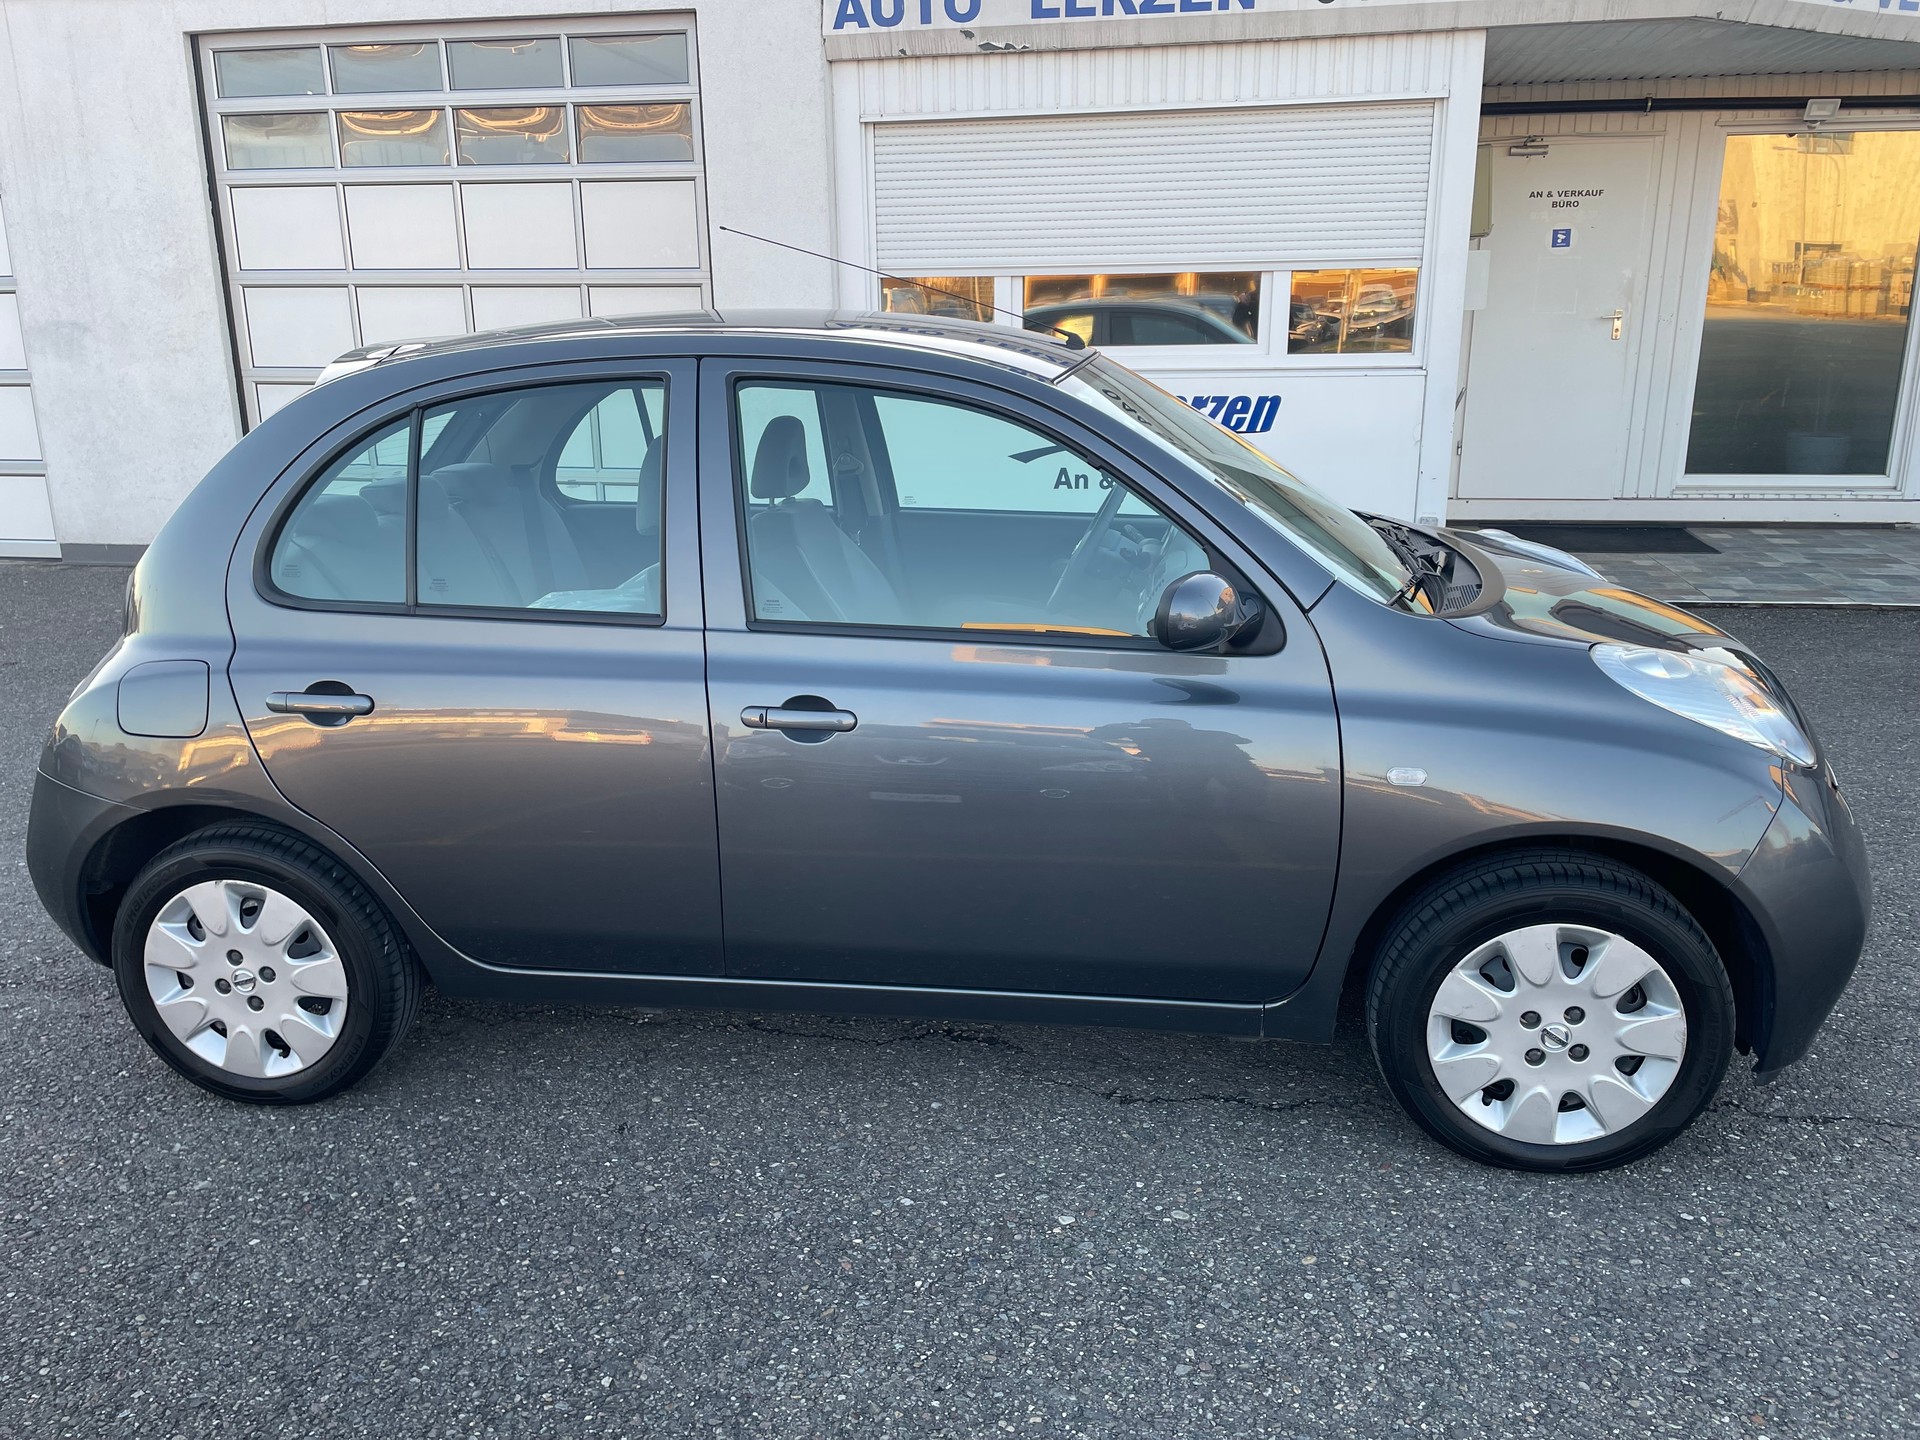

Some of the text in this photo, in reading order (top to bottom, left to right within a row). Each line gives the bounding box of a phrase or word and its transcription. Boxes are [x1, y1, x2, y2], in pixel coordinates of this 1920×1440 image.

[833, 0, 981, 29] AUTO
[1529, 189, 1605, 199] AN & VERKAUF
[1551, 200, 1580, 208] BÜRO
[1053, 467, 1089, 490] An
